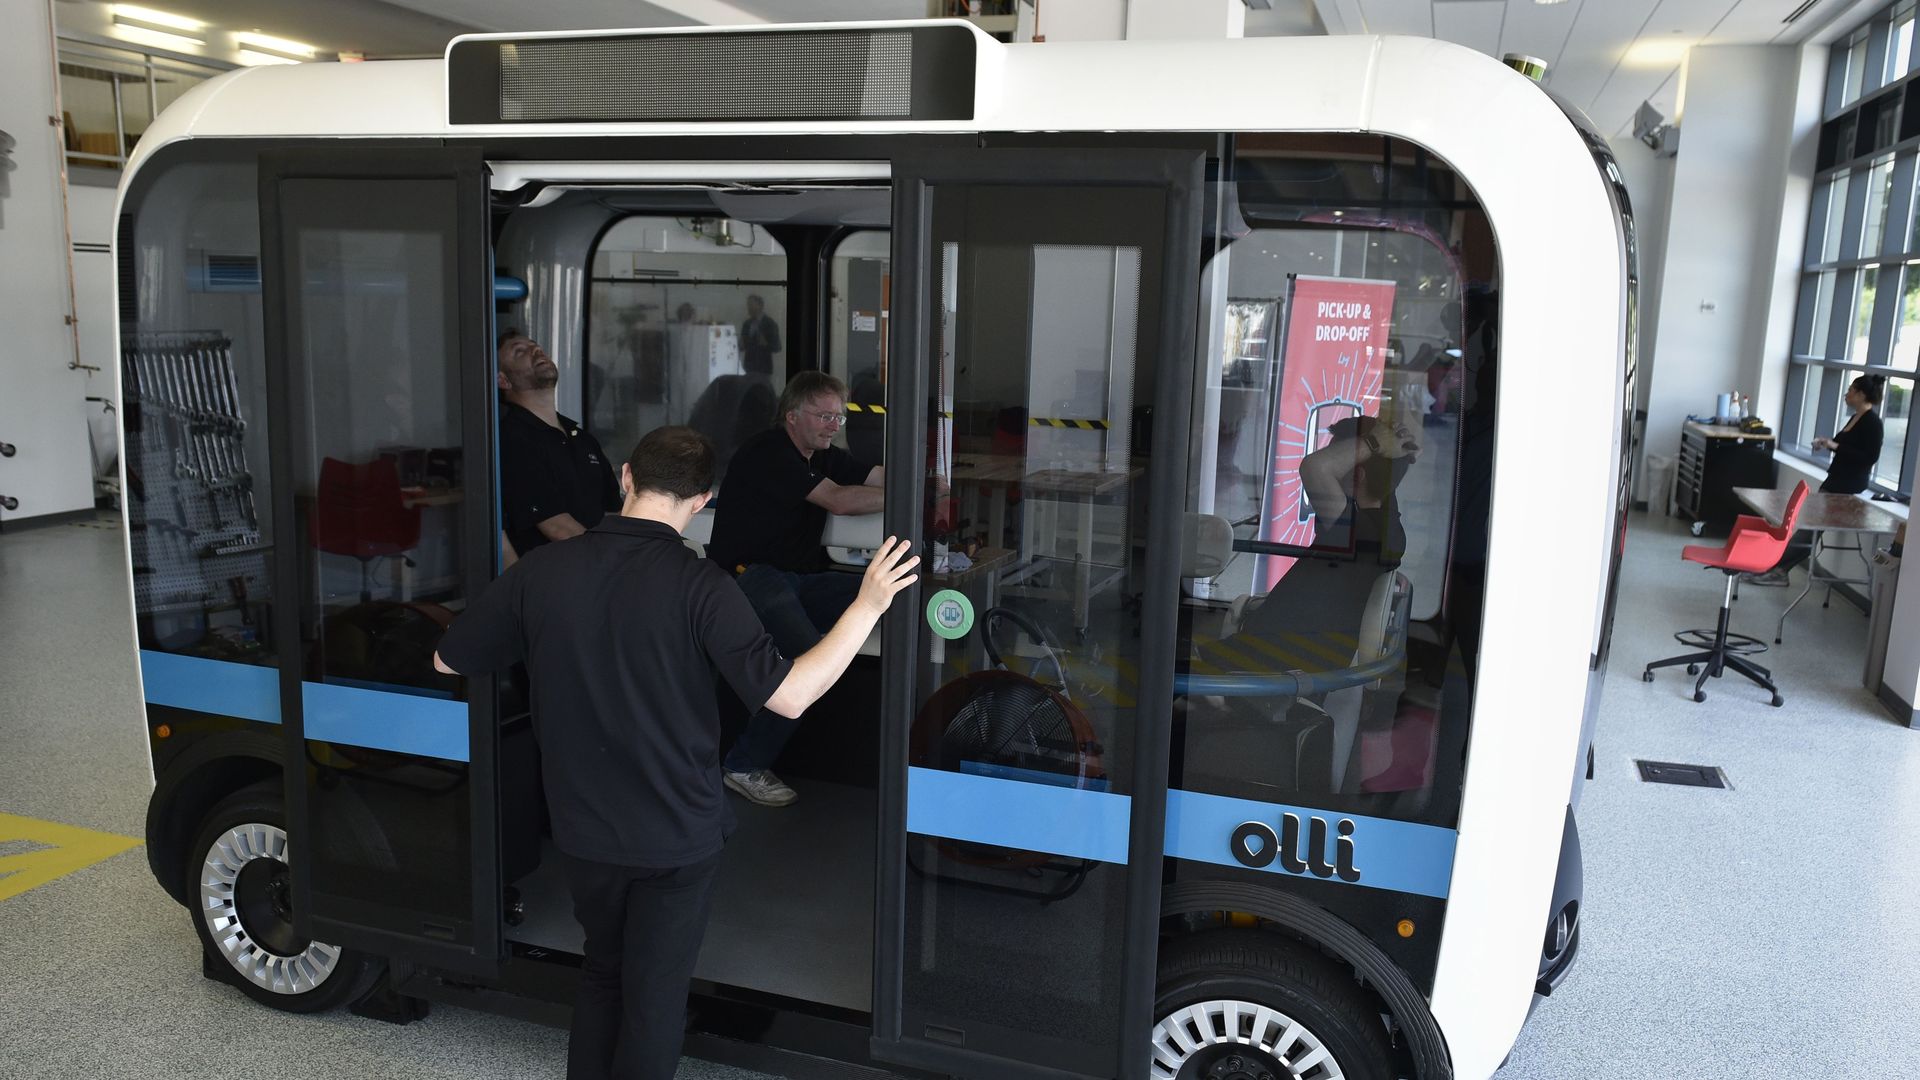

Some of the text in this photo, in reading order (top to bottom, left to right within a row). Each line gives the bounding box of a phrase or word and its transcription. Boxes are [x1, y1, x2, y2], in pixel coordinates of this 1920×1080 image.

[1317, 302, 1372, 320] PICK-UP &
[1315, 325, 1370, 342] DROP-OFF
[1230, 812, 1361, 883] olli
